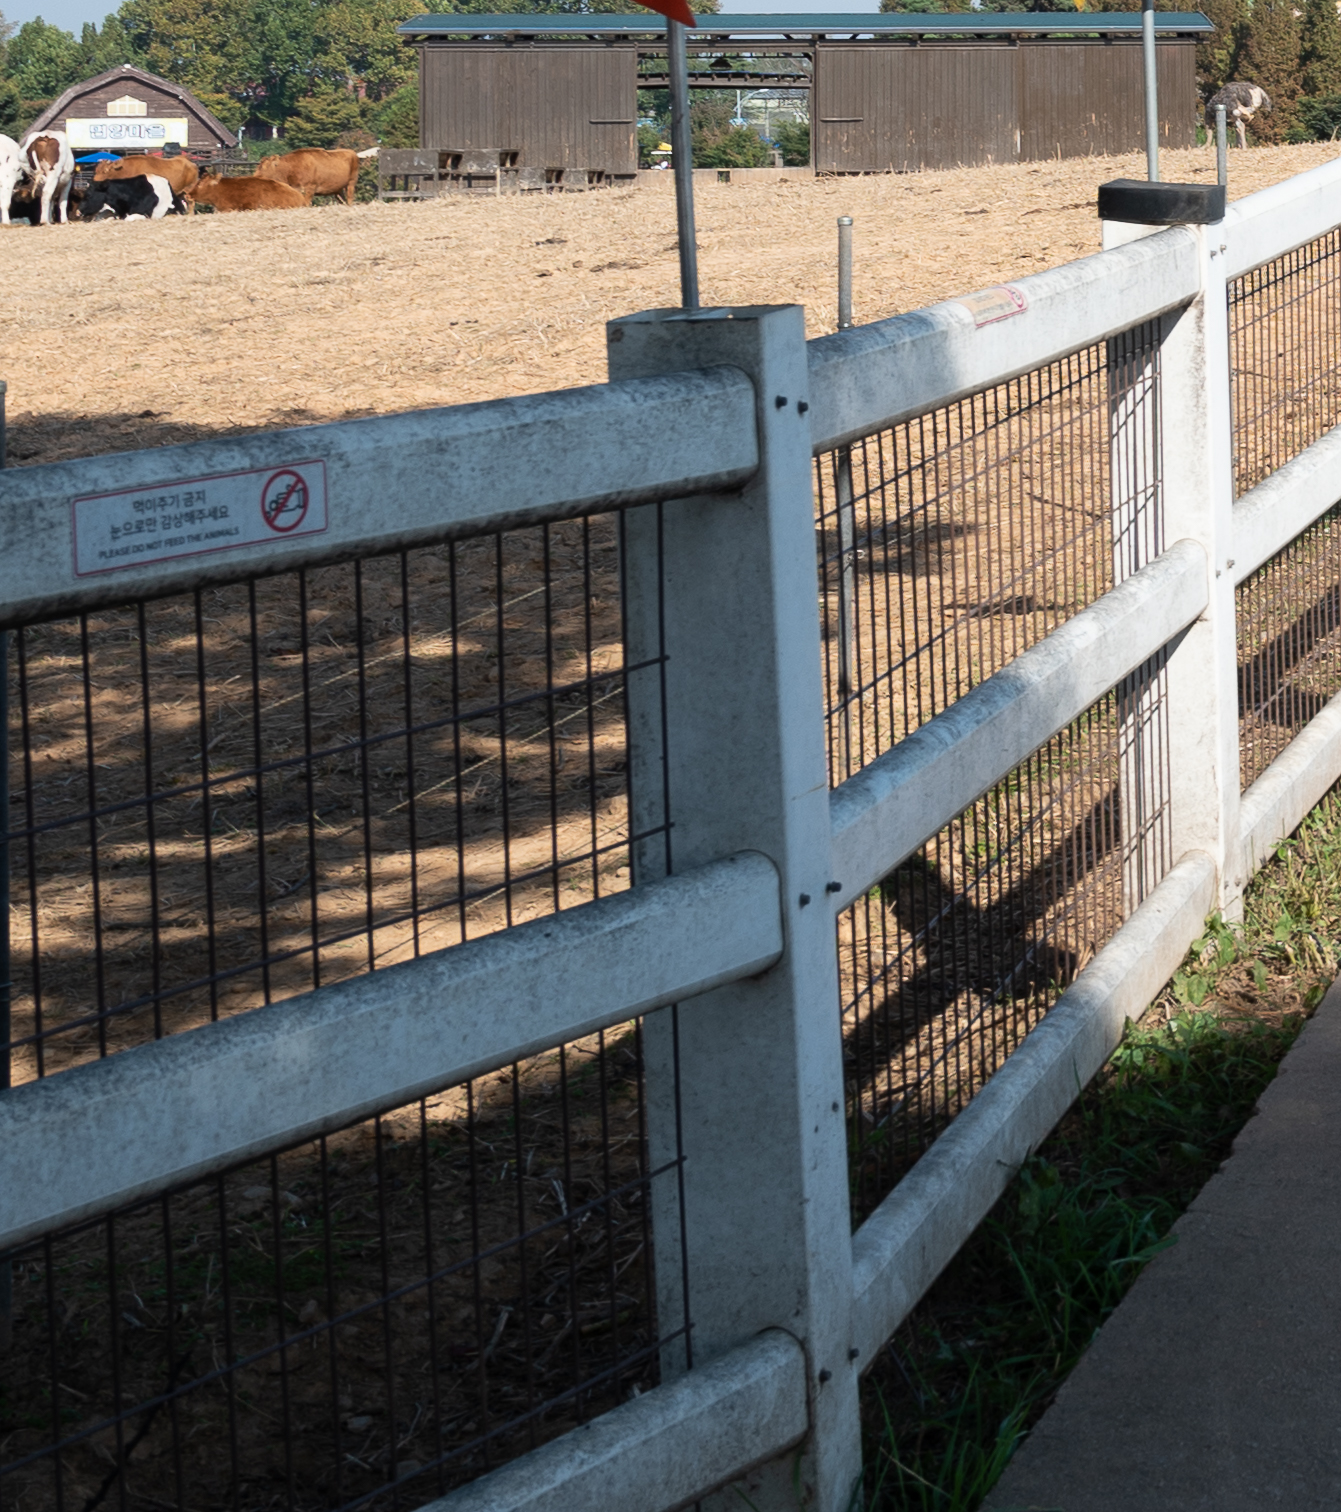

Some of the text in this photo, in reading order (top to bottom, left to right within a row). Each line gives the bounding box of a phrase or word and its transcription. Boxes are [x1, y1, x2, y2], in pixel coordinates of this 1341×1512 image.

[132, 489, 206, 515] 먹이주기 금지
[110, 505, 230, 542] 눈으로만 감상해주세요
[98, 526, 240, 560] PLEASE DO NOT FEED THE ANIMALS
